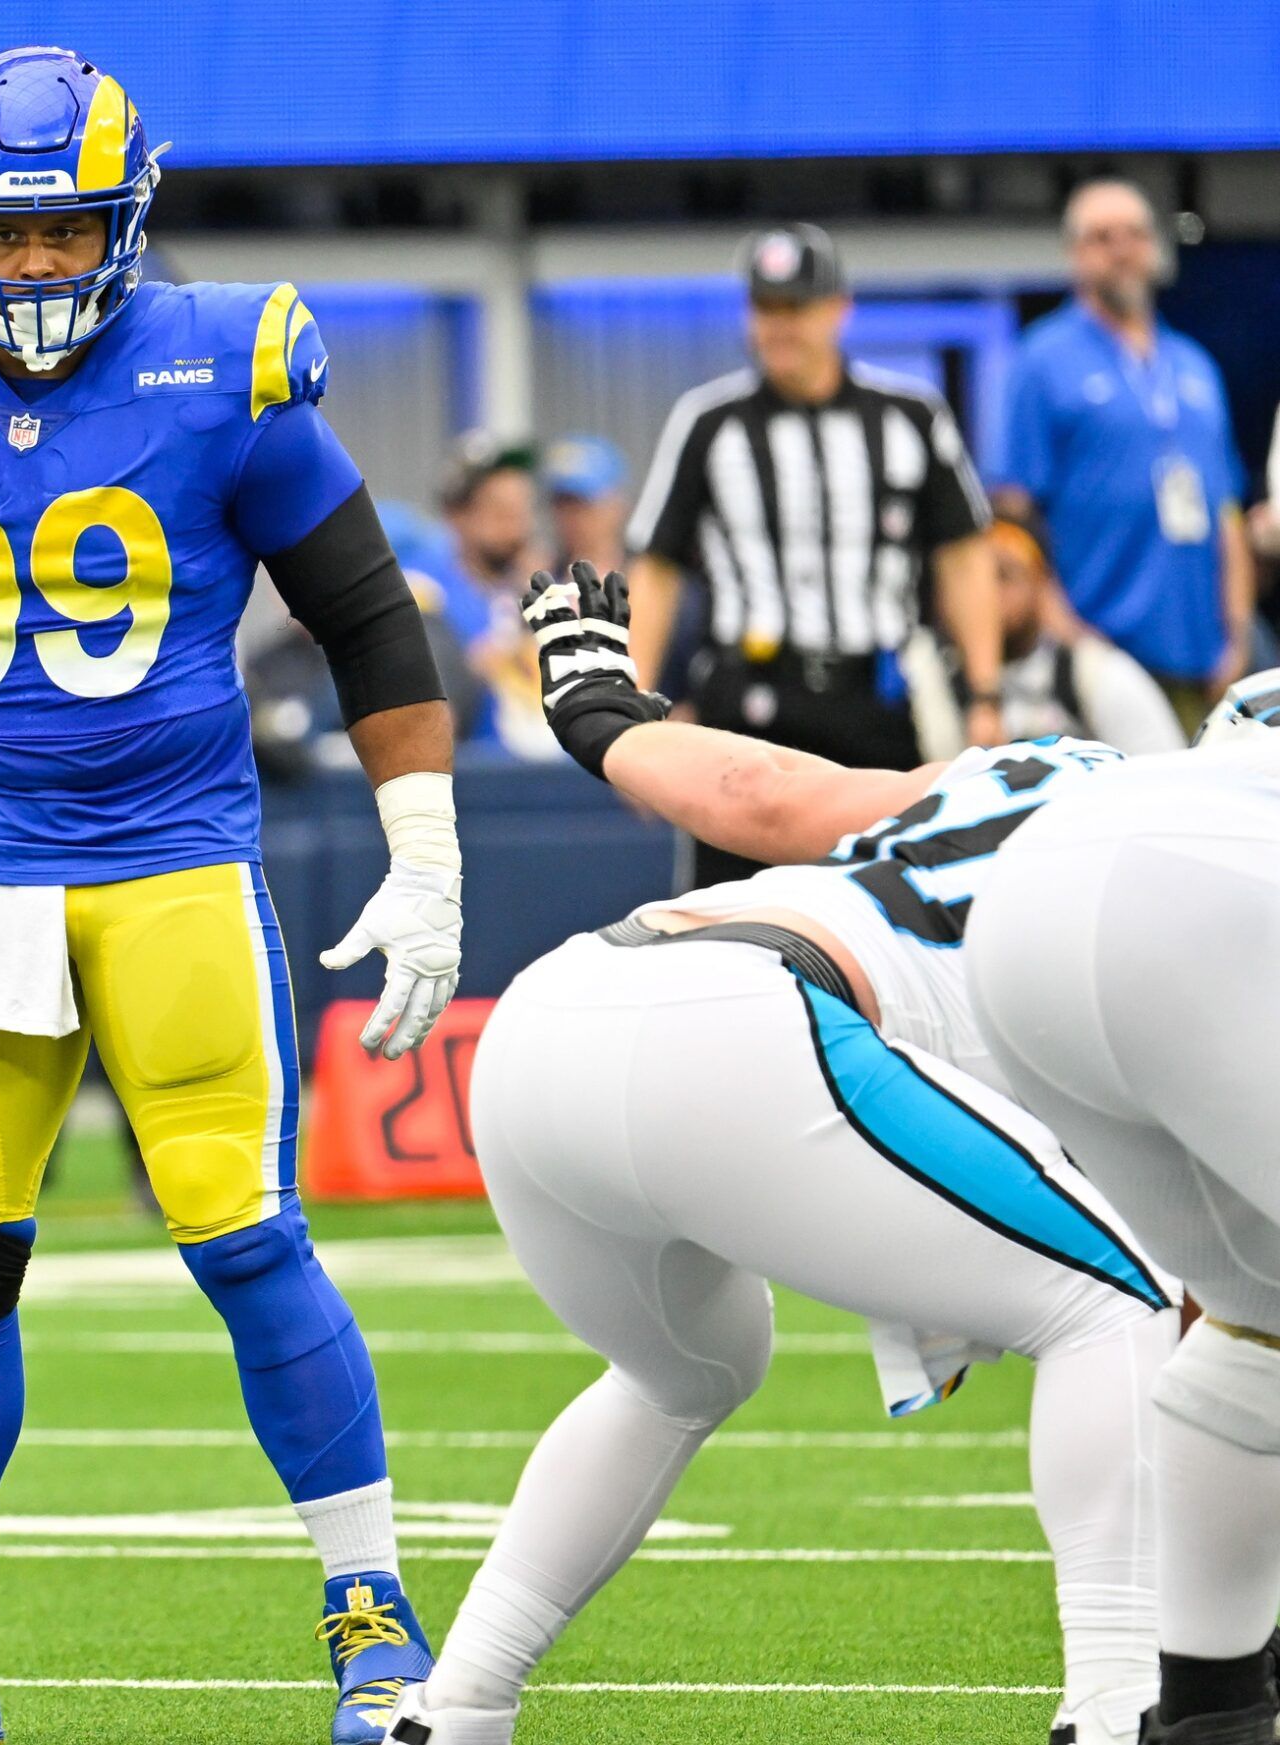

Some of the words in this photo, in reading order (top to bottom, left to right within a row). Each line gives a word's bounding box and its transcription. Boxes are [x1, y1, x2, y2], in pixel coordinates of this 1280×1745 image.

[9, 175, 57, 186] RAMS
[138, 368, 215, 387] RAMS
[13, 429, 35, 445] NFL
